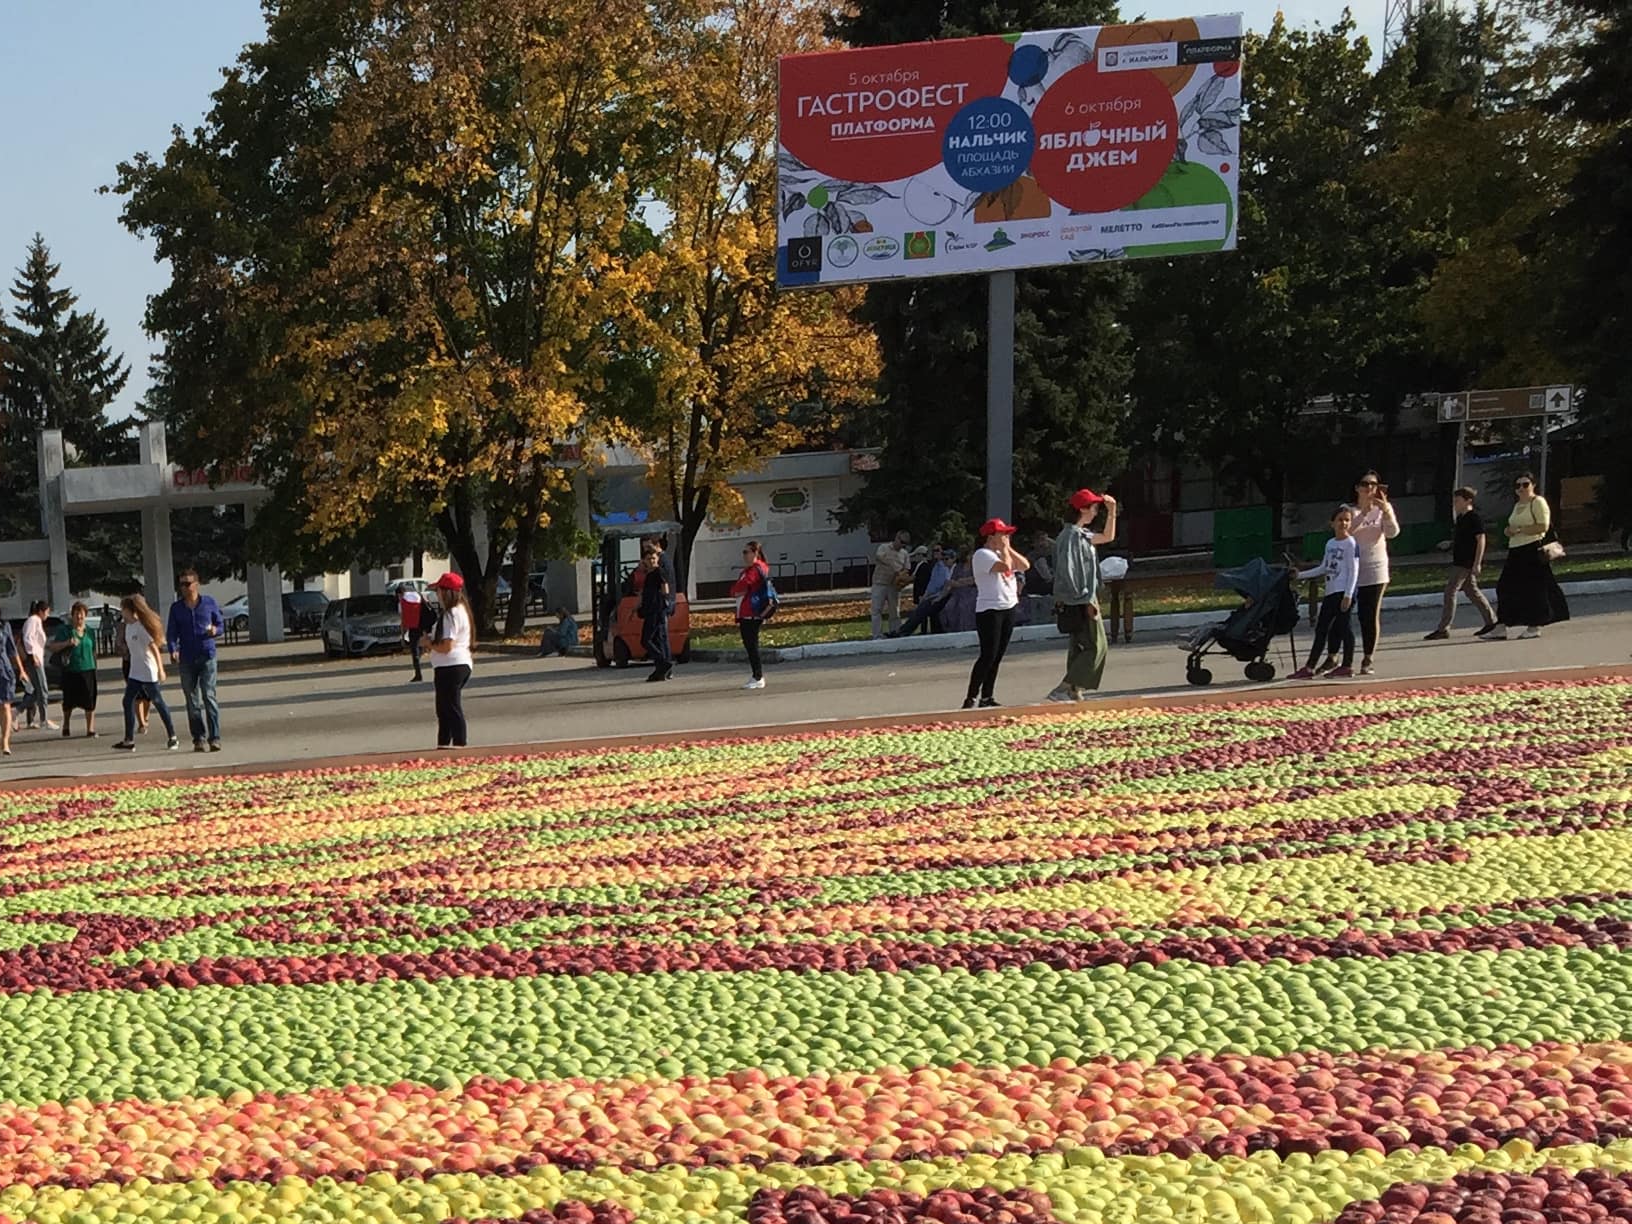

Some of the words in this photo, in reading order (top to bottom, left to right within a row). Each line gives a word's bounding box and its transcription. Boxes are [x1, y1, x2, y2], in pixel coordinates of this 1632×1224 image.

[848, 72, 858, 86] 5
[861, 68, 920, 85] октября
[797, 82, 969, 118] ГАСТРОФЕСТ
[1064, 101, 1074, 116] 6
[1079, 96, 1142, 114] октября
[831, 116, 935, 137] ПЛАТФОРМА
[968, 112, 1012, 130] 12:00
[948, 130, 1028, 149] НАЛЬЧИК
[957, 150, 1019, 164] ПЛОЩАДЬ
[1066, 149, 1137, 173] ДЖЕМ
[961, 164, 1015, 177] АБХАЗИИ
